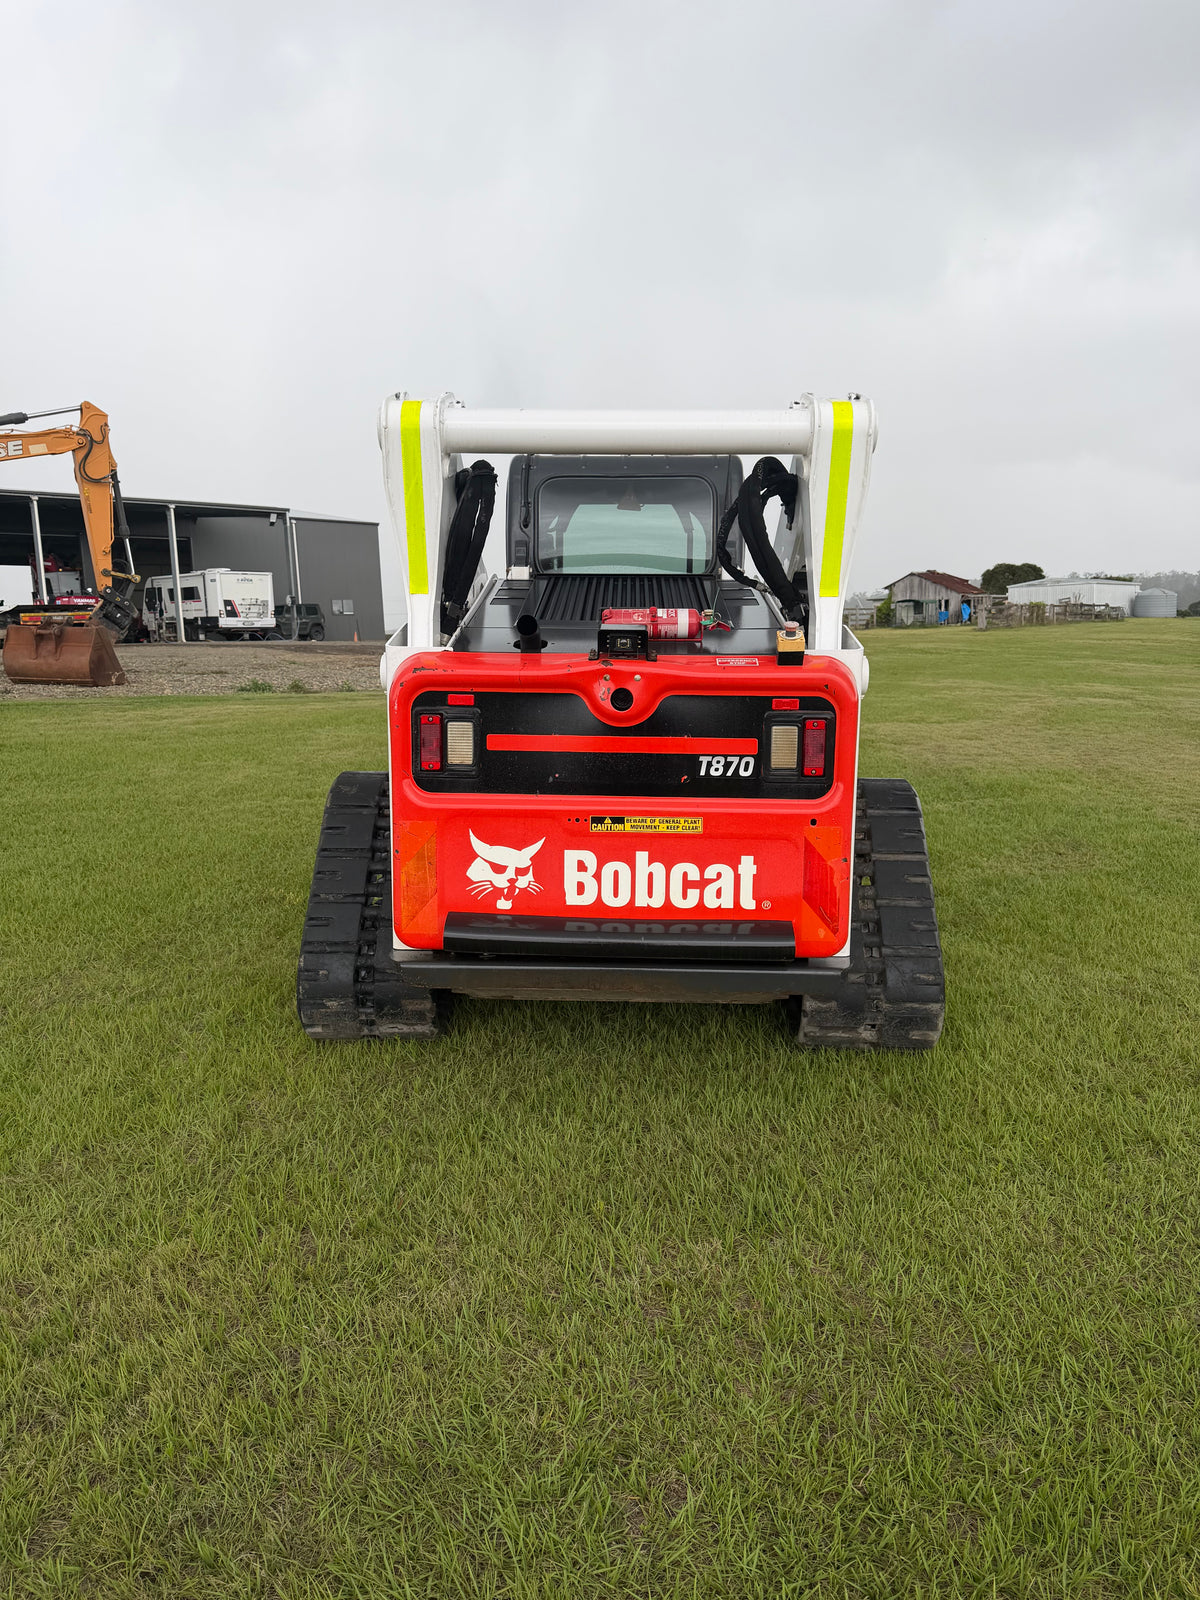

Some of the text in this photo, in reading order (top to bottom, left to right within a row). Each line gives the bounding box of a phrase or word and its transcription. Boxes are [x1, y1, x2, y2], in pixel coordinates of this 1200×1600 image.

[699, 756, 755, 777] T870
[591, 823, 625, 831] CAUTION
[564, 850, 757, 910] Bobcat
